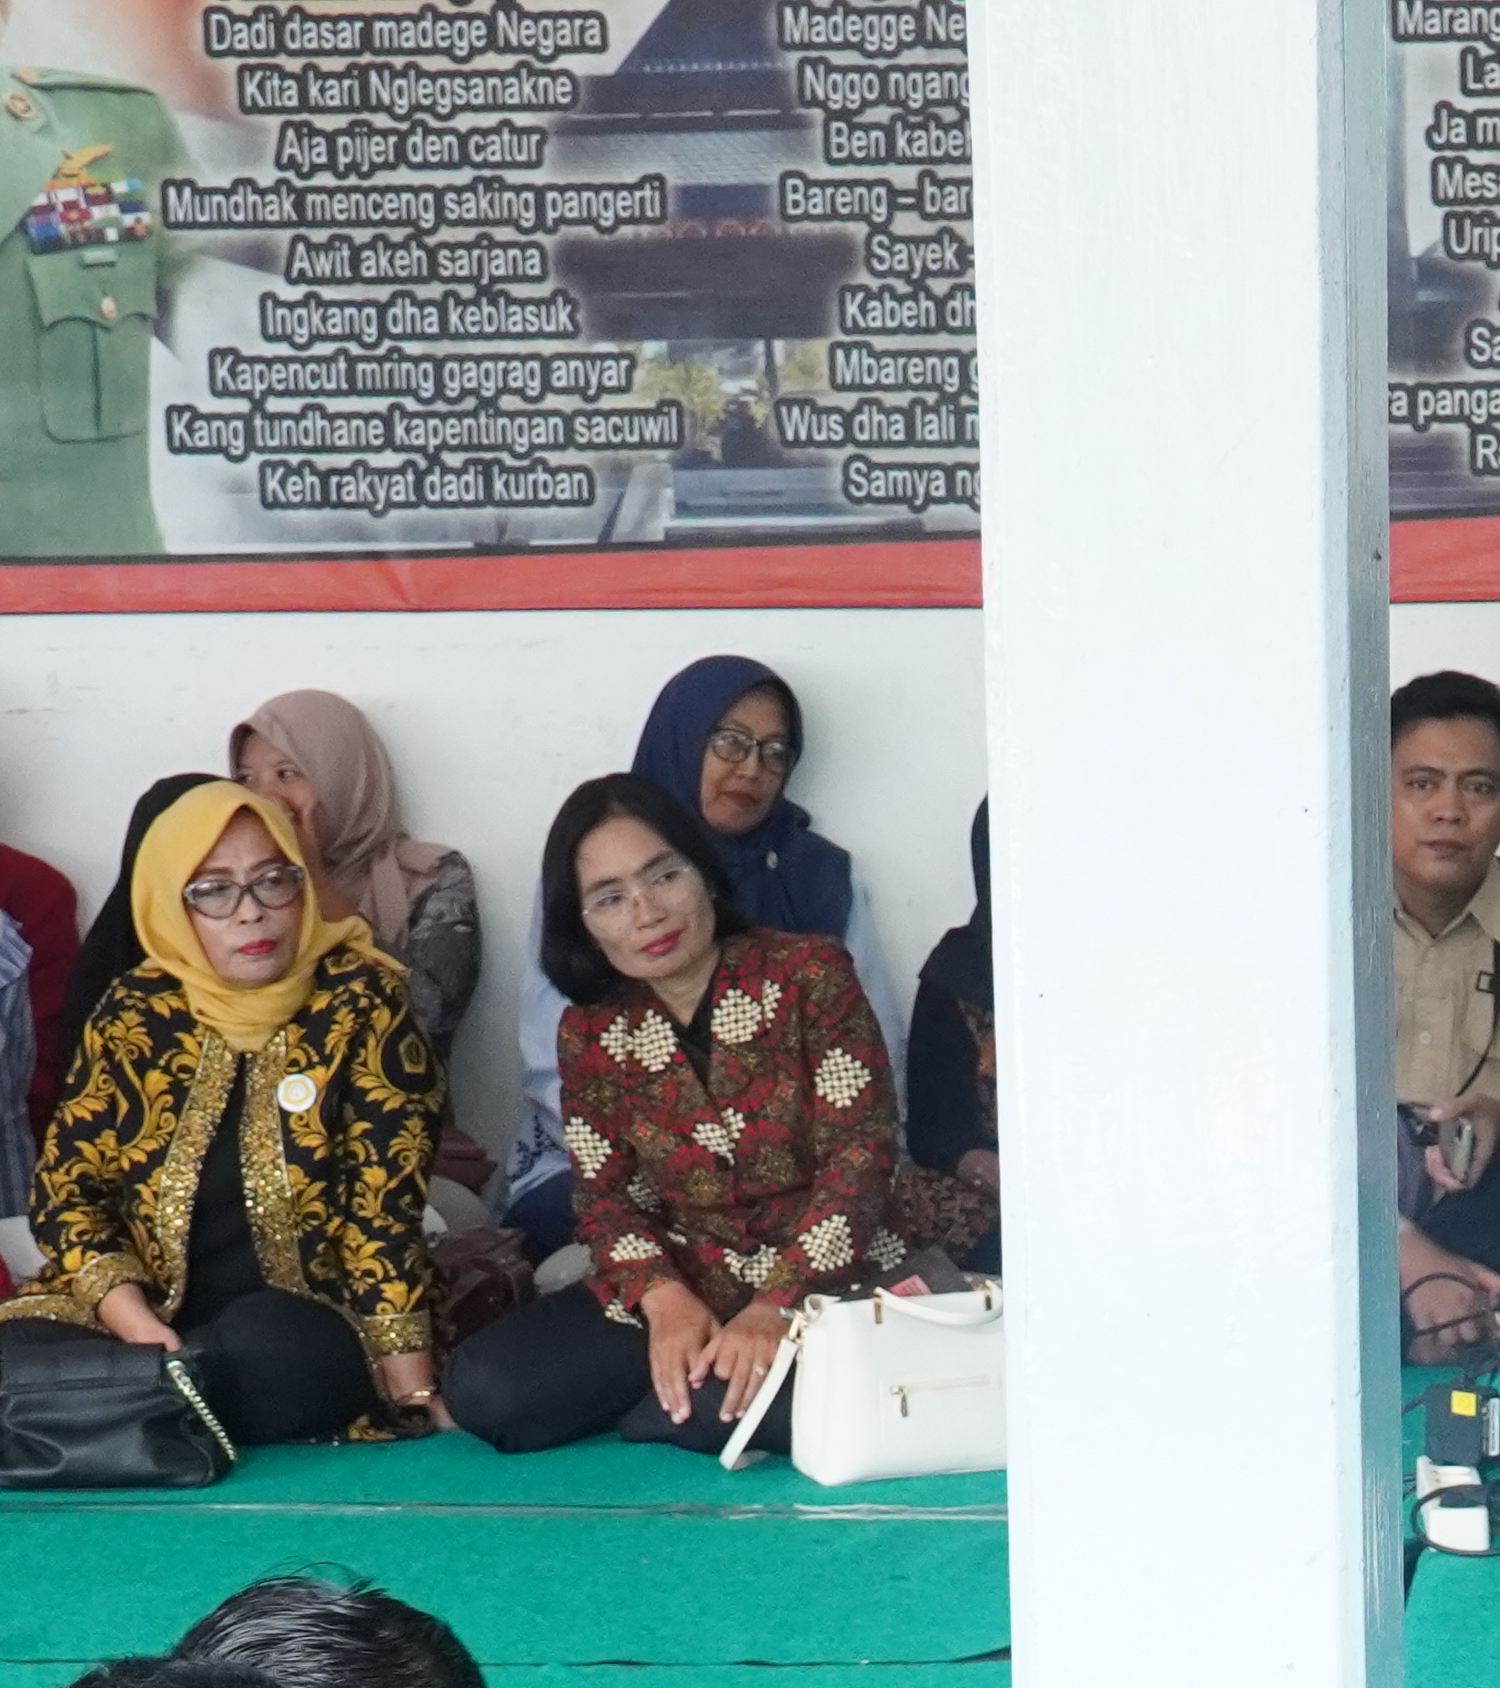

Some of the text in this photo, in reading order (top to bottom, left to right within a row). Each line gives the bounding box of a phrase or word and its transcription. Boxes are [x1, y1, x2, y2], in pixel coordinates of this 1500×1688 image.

[209, 13, 601, 58] Dadi dasar madege Negara
[783, 6, 916, 51] Madegge
[243, 71, 573, 113] Kita kari Nglegsanakne
[803, 64, 880, 109] Nggo
[281, 128, 541, 173] Aja pijer den catur
[830, 121, 886, 159] Ben
[1431, 111, 1467, 145] Ja
[167, 182, 661, 229] Mundhak menceng saking pangerti
[785, 177, 888, 223] Bareng
[924, 177, 973, 214] bar
[289, 242, 543, 285] Awit akeh sarjana
[869, 234, 961, 280] Sayek
[264, 298, 575, 344] Ingkang dha keblasuk
[845, 289, 937, 330] Kabeh
[213, 355, 632, 398] Kapencut mring gagrag anyar
[833, 347, 961, 392] Mbareng
[171, 406, 679, 453] Kang tundhane kapentingan sacuwil
[779, 405, 844, 442] Wus
[853, 404, 906, 442] dha
[915, 403, 956, 441] lali
[264, 463, 590, 511] Keh rakyat dadi kurban
[849, 461, 948, 505] Samya
